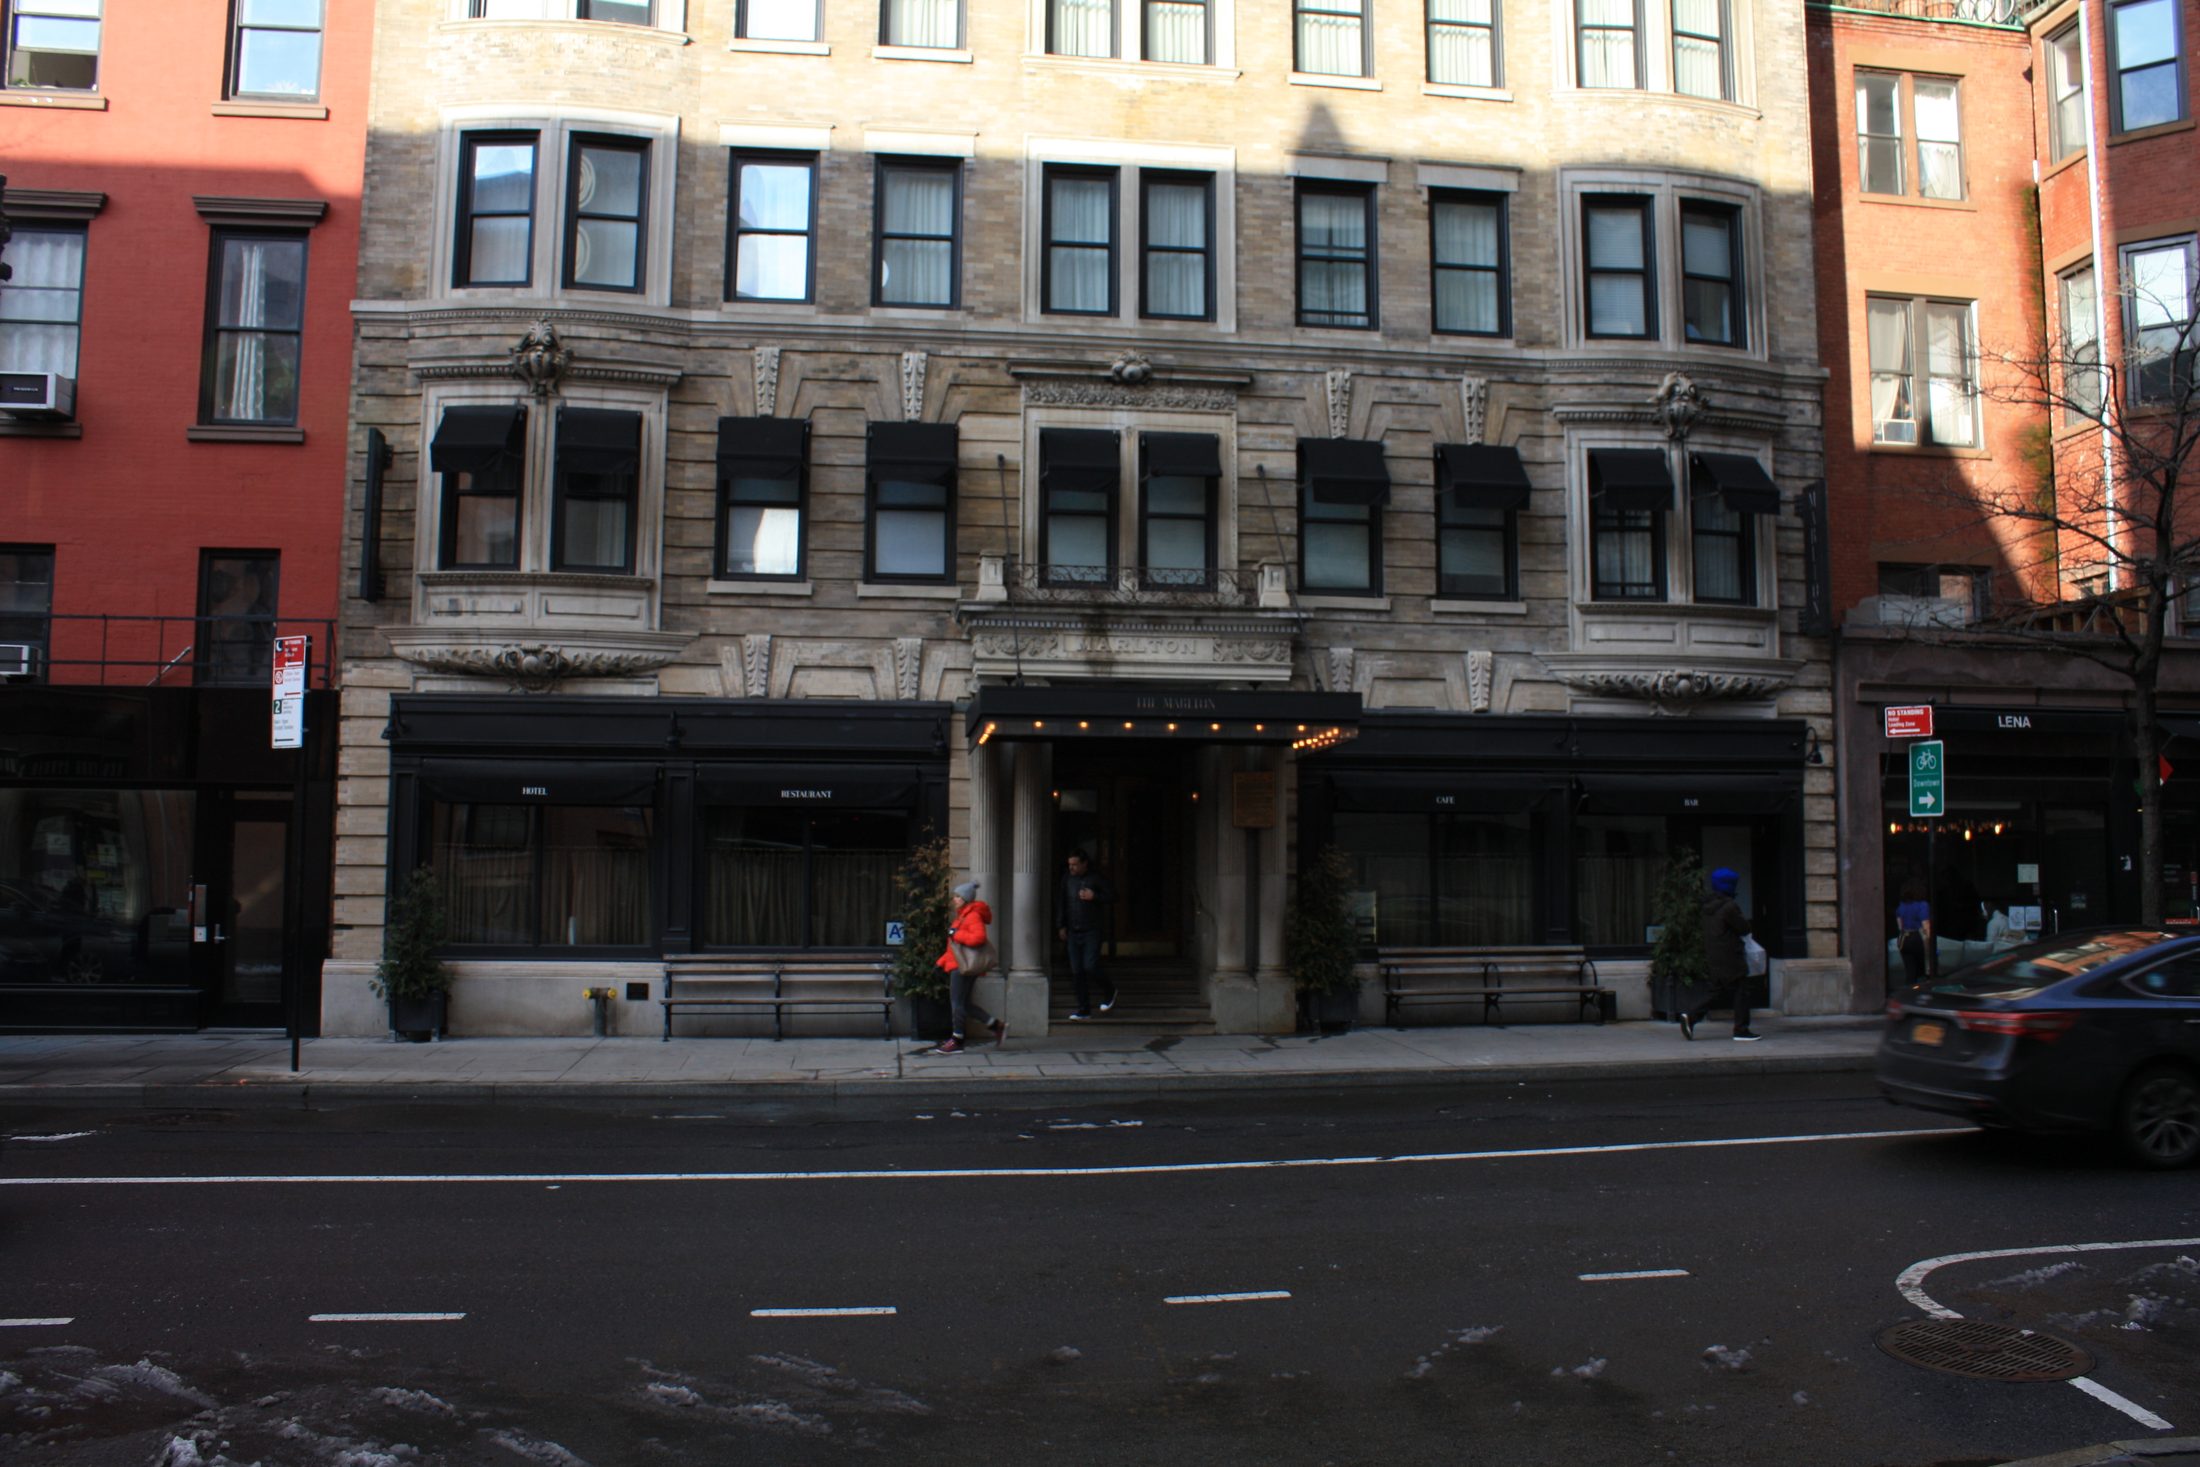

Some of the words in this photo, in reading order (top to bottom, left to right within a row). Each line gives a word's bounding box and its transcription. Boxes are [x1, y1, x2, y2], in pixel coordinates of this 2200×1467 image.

[1075, 636, 1198, 655] MARLTON
[1998, 715, 2032, 728] LENA
[1913, 779, 1940, 788] Downtown
[522, 786, 548, 796] HOTEL
[781, 790, 832, 799] RESTAURANT
[889, 924, 901, 938] A
